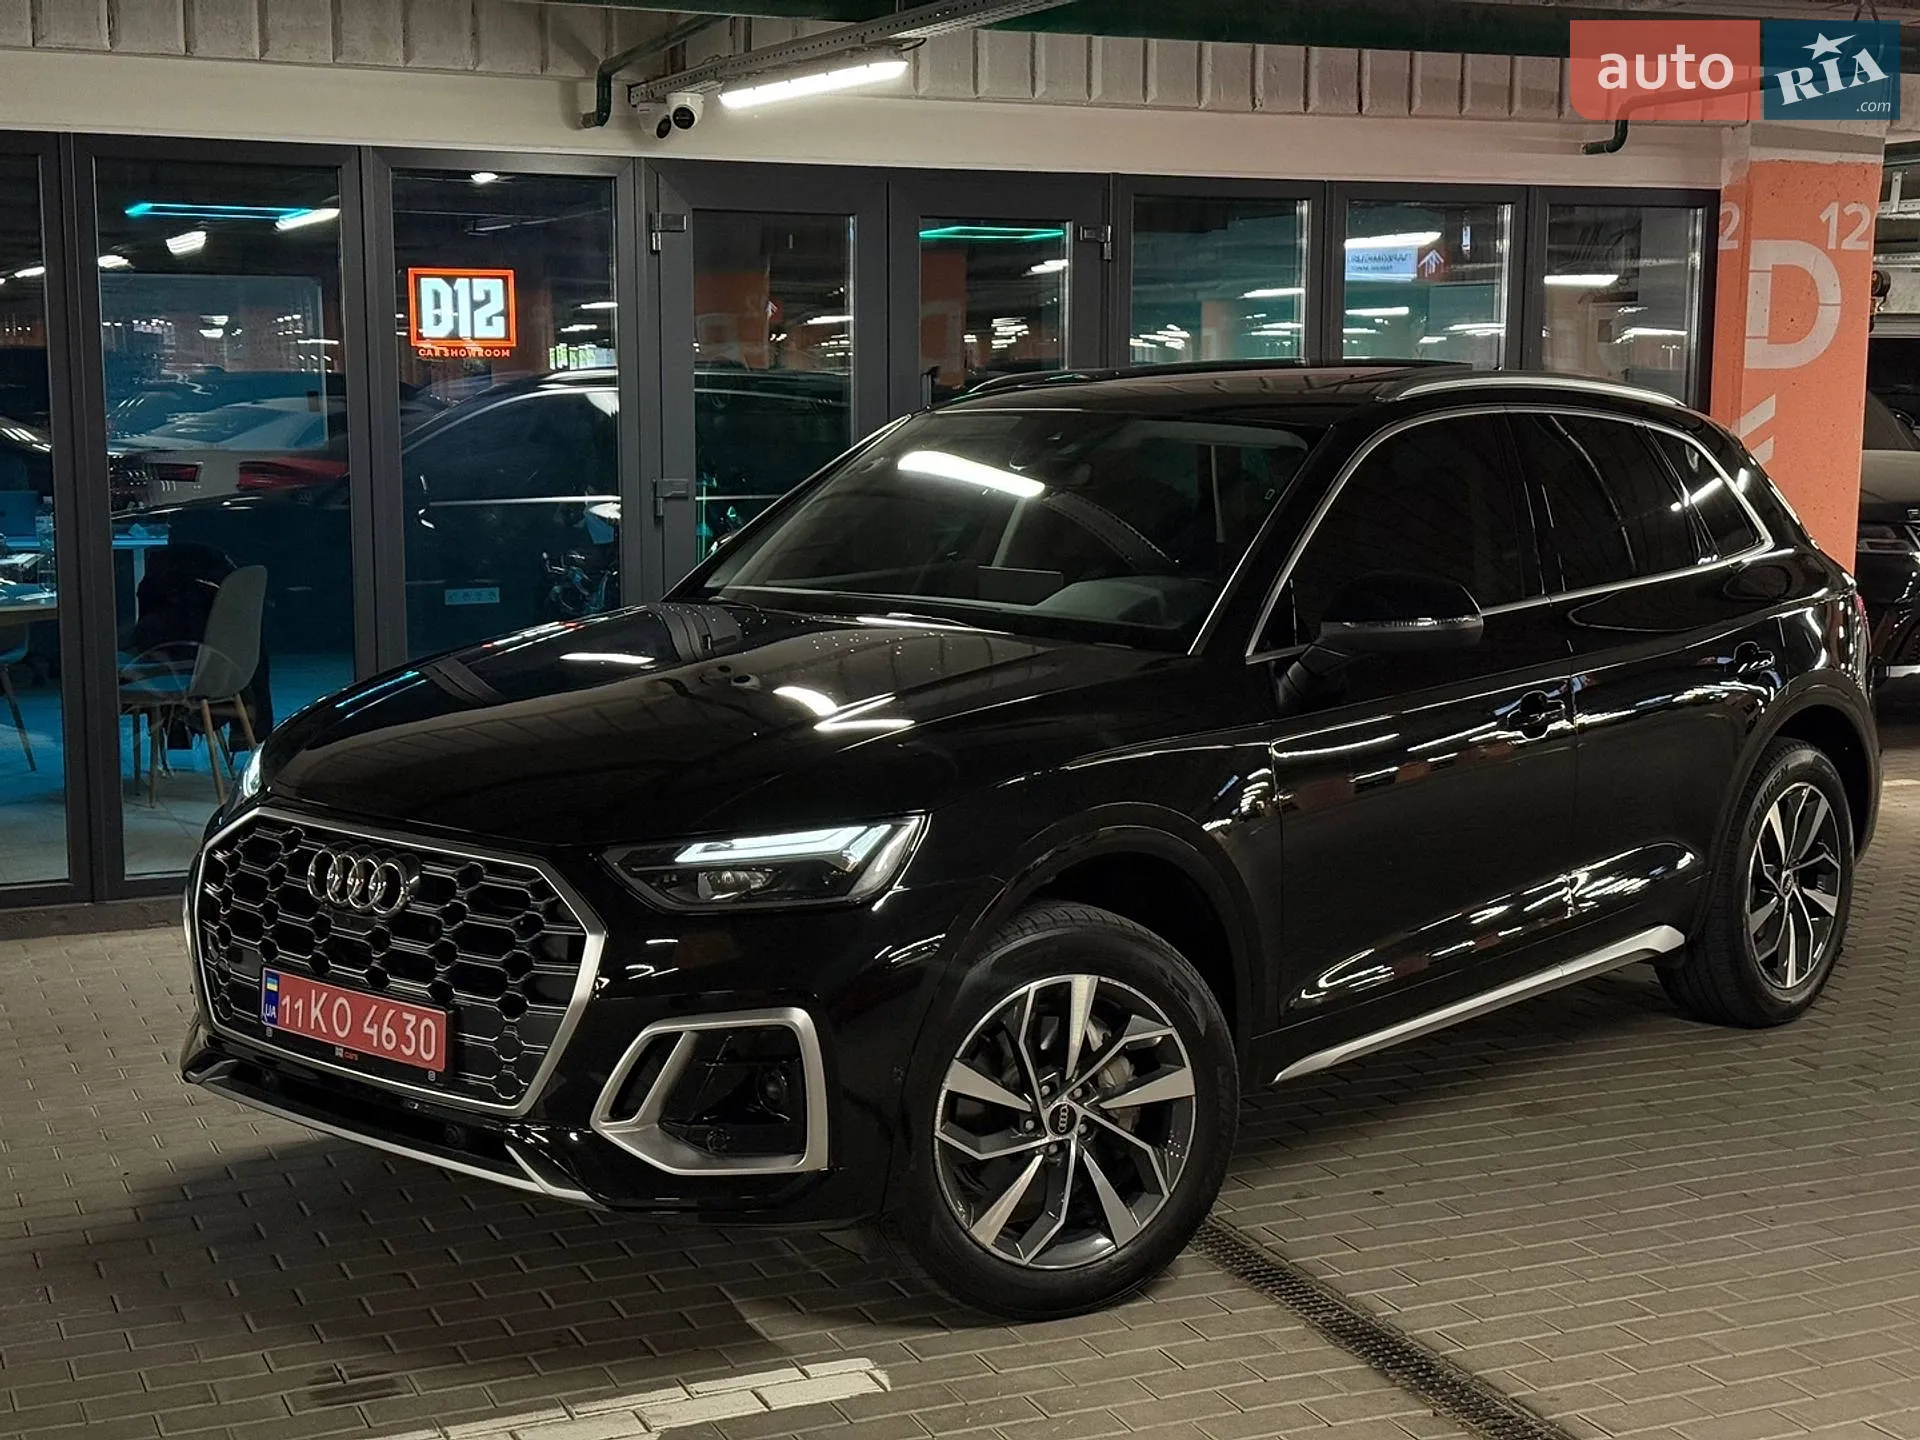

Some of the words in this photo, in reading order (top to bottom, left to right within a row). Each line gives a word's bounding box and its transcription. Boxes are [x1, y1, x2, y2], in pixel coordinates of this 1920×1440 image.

[1819, 201, 1870, 250] 12
[1745, 239, 1841, 369] D
[265, 1003, 277, 1019] UA
[363, 1005, 436, 1061] 4630
